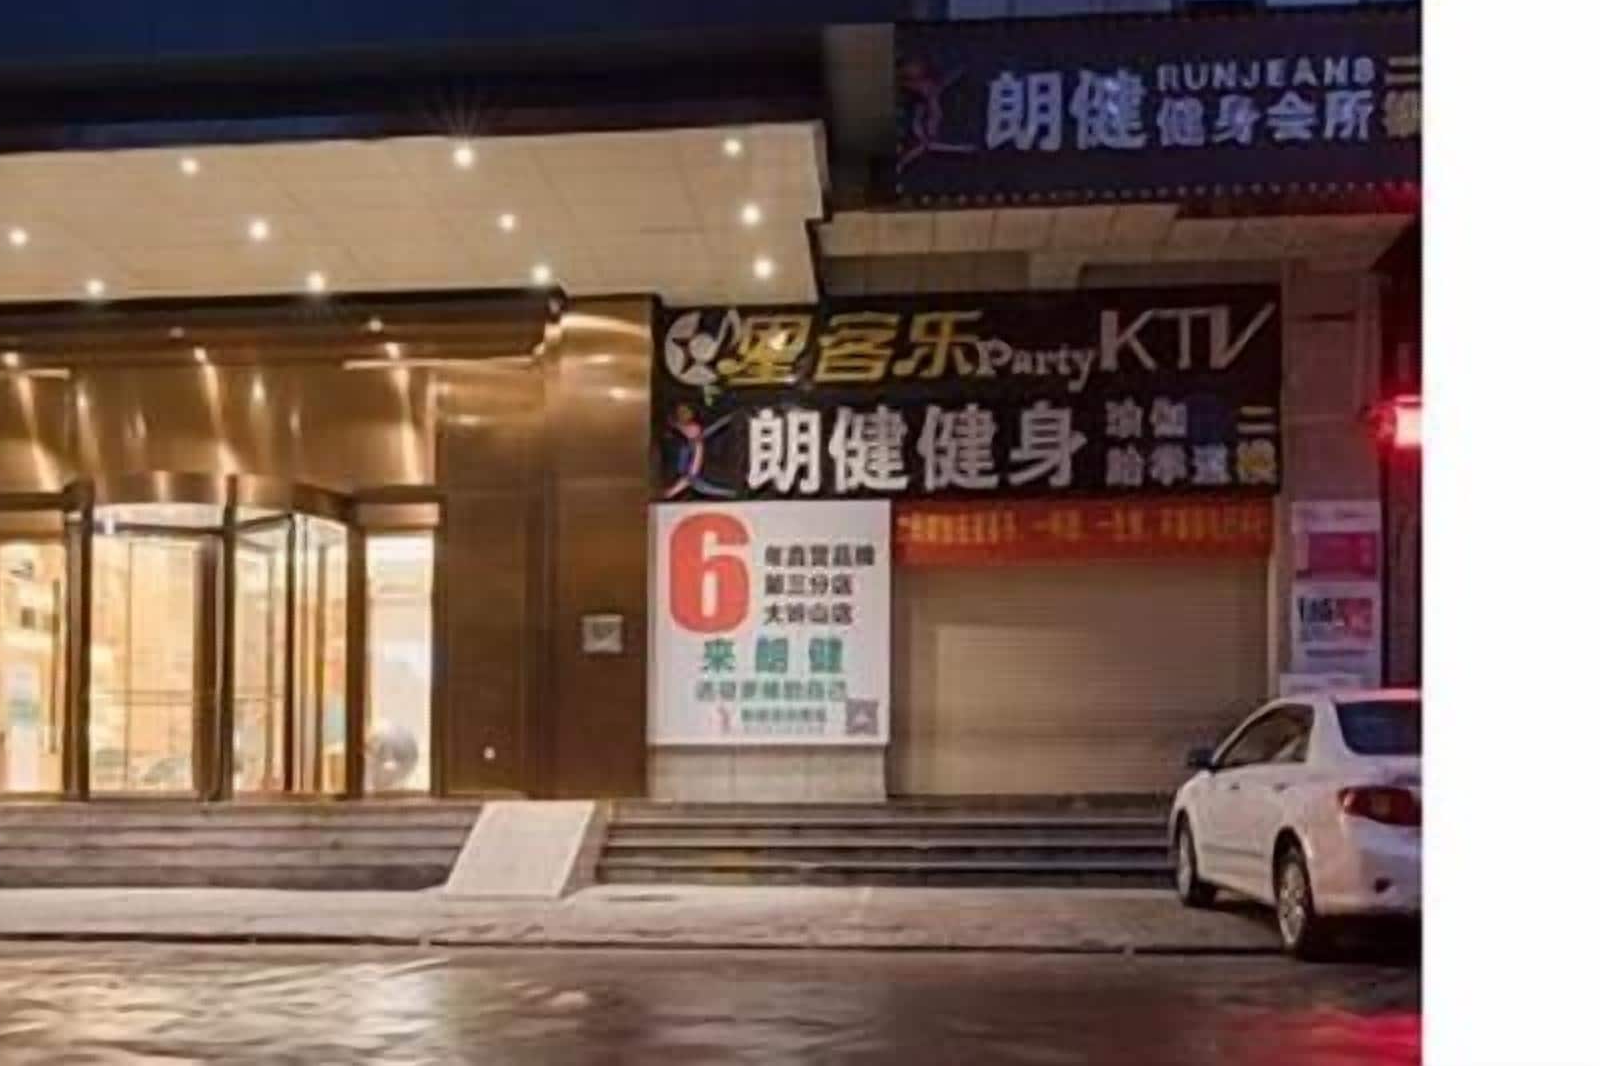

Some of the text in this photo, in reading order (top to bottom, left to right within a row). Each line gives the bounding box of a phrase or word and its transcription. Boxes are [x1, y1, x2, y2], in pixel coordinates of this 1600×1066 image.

[985, 70, 1148, 152] 朗健
[1156, 56, 1376, 91] RUNJEANS
[1155, 91, 1376, 148] 健身会所
[976, 303, 1276, 392] Party KTV
[747, 400, 1088, 493] 朗健健身
[669, 511, 750, 635] 6
